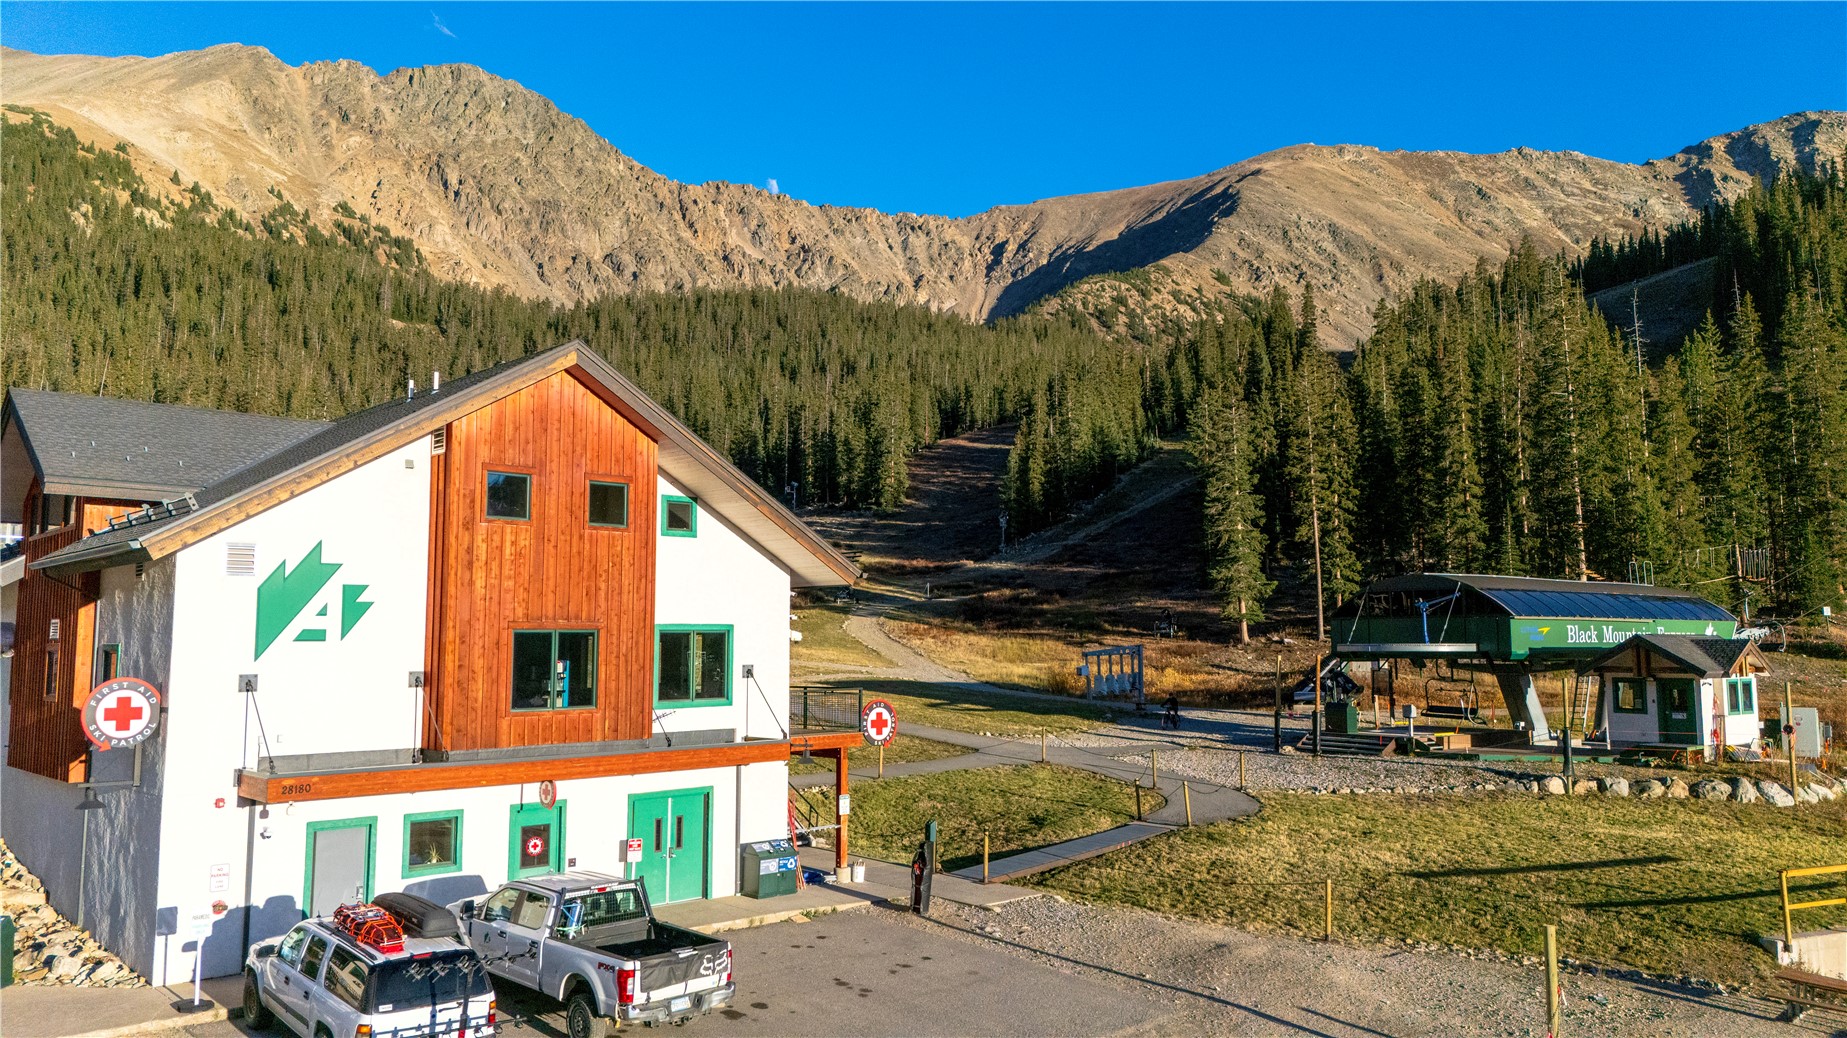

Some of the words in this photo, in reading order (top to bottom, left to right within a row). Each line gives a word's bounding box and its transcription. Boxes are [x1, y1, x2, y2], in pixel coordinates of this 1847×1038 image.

[1566, 625, 1598, 643] Black
[90, 682, 129, 707] FIRST
[137, 686, 157, 704] AID
[89, 724, 106, 742] SKI
[111, 722, 157, 747] PATROL
[281, 783, 311, 795] 28180
